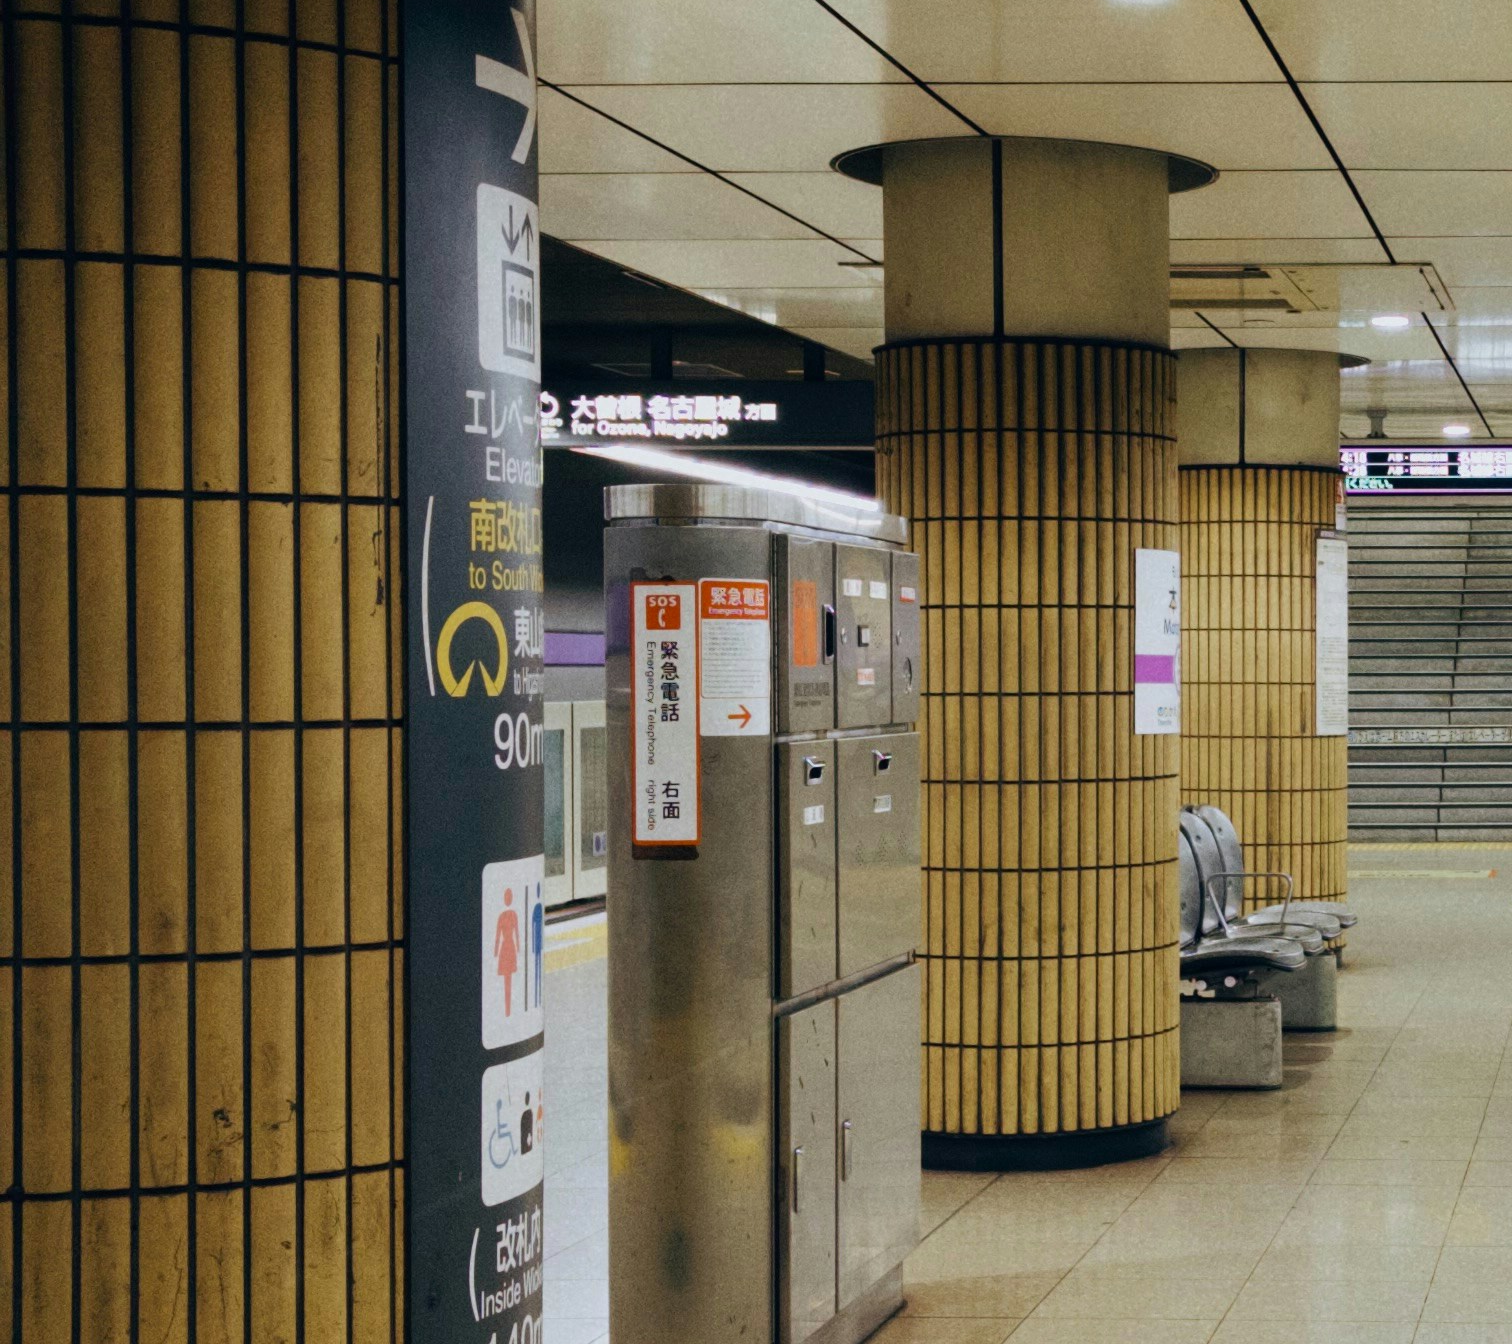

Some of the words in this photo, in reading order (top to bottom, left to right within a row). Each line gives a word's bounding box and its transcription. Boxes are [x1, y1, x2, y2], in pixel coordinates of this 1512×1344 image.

[572, 421, 595, 436] for
[654, 421, 728, 440] Nagoyajo
[469, 562, 487, 590] to
[492, 560, 529, 591] South
[649, 596, 677, 607] SOS
[514, 606, 544, 658] 東山
[645, 641, 656, 704] Emergency
[661, 641, 680, 722] 緊急電話
[494, 712, 543, 770] 90m
[646, 708, 656, 765] Telephone
[645, 780, 656, 804] right
[662, 780, 680, 820] 右面
[648, 808, 656, 831] side
[481, 1278, 521, 1319] Inside
